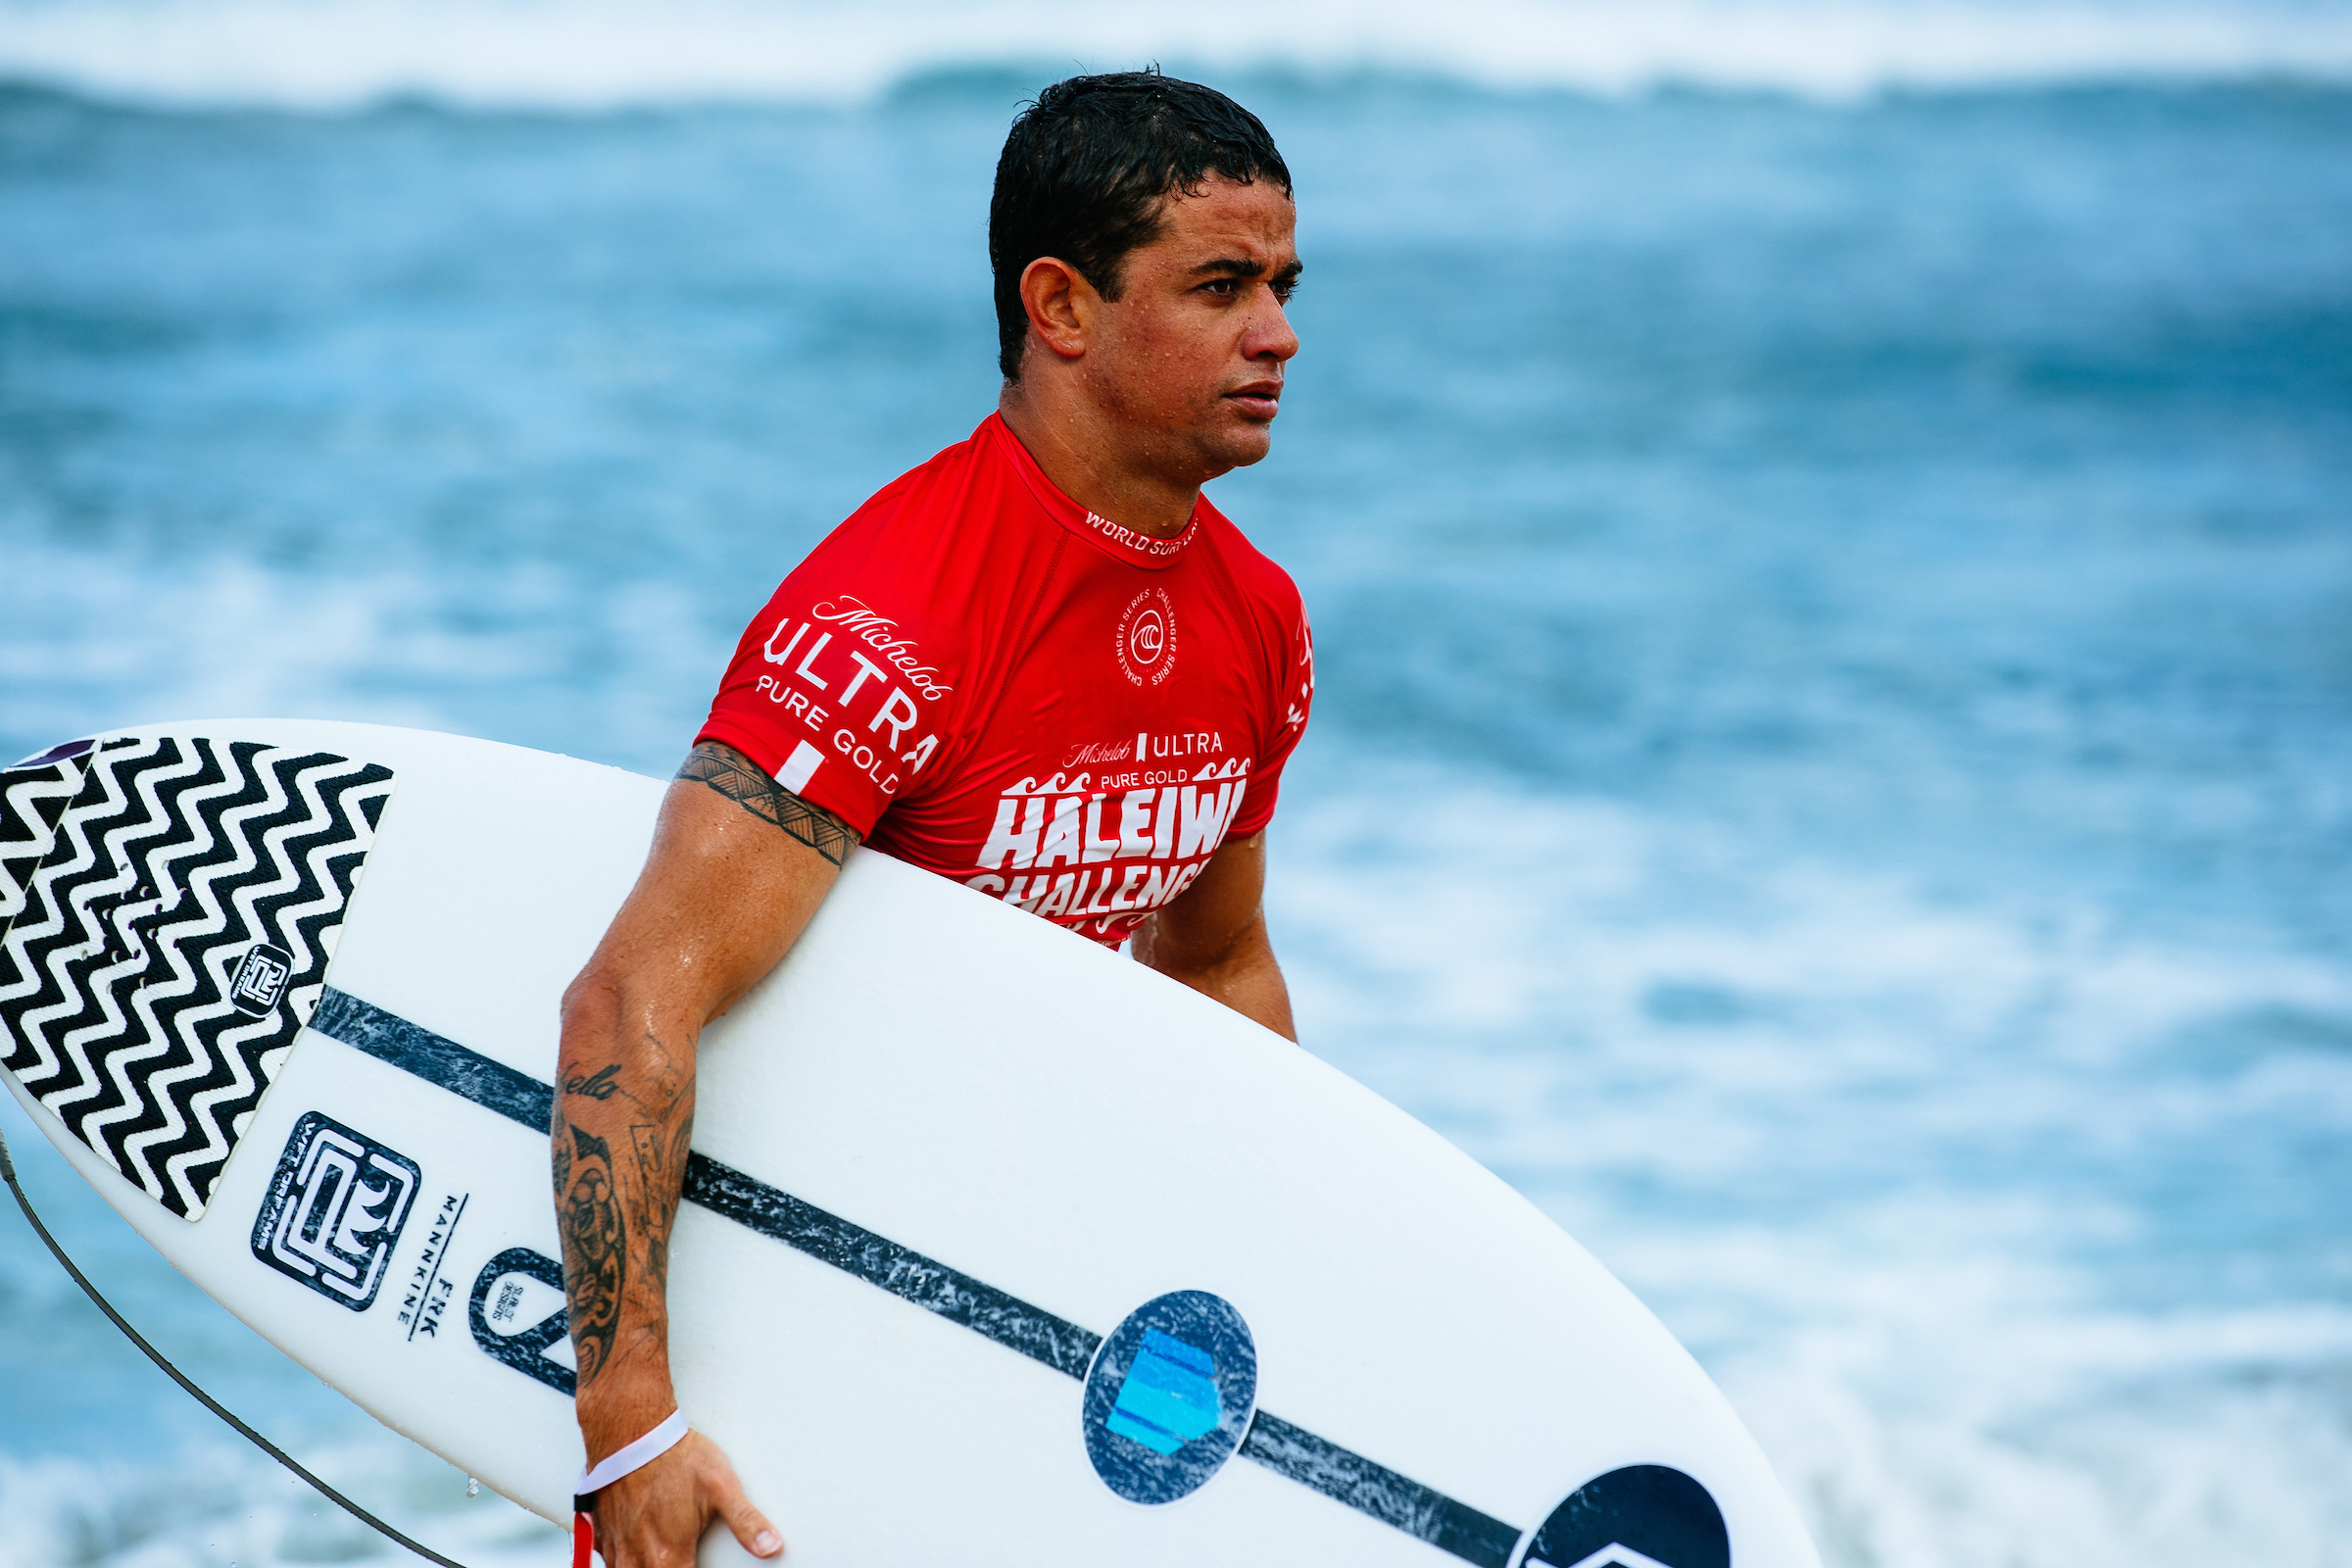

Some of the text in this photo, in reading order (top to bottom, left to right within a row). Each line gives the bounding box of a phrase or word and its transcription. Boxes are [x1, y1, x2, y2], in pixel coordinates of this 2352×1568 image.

[1085, 511, 1151, 551] WORLD
[1122, 588, 1151, 621] SERIES
[812, 594, 954, 702] Michelob
[1116, 623, 1143, 687] CHALLENGER
[1152, 587, 1177, 686] CHALLENGER SERIES
[762, 617, 940, 776] ULTRA
[755, 674, 900, 795] PURE GOLD
[1062, 731, 1224, 768] Michelob ULTRA
[1101, 768, 1188, 789] PURE GOLD
[964, 857, 1212, 917] CHALLENG
[397, 1195, 458, 1325] MANNKINE
[419, 1277, 454, 1339] FRK
